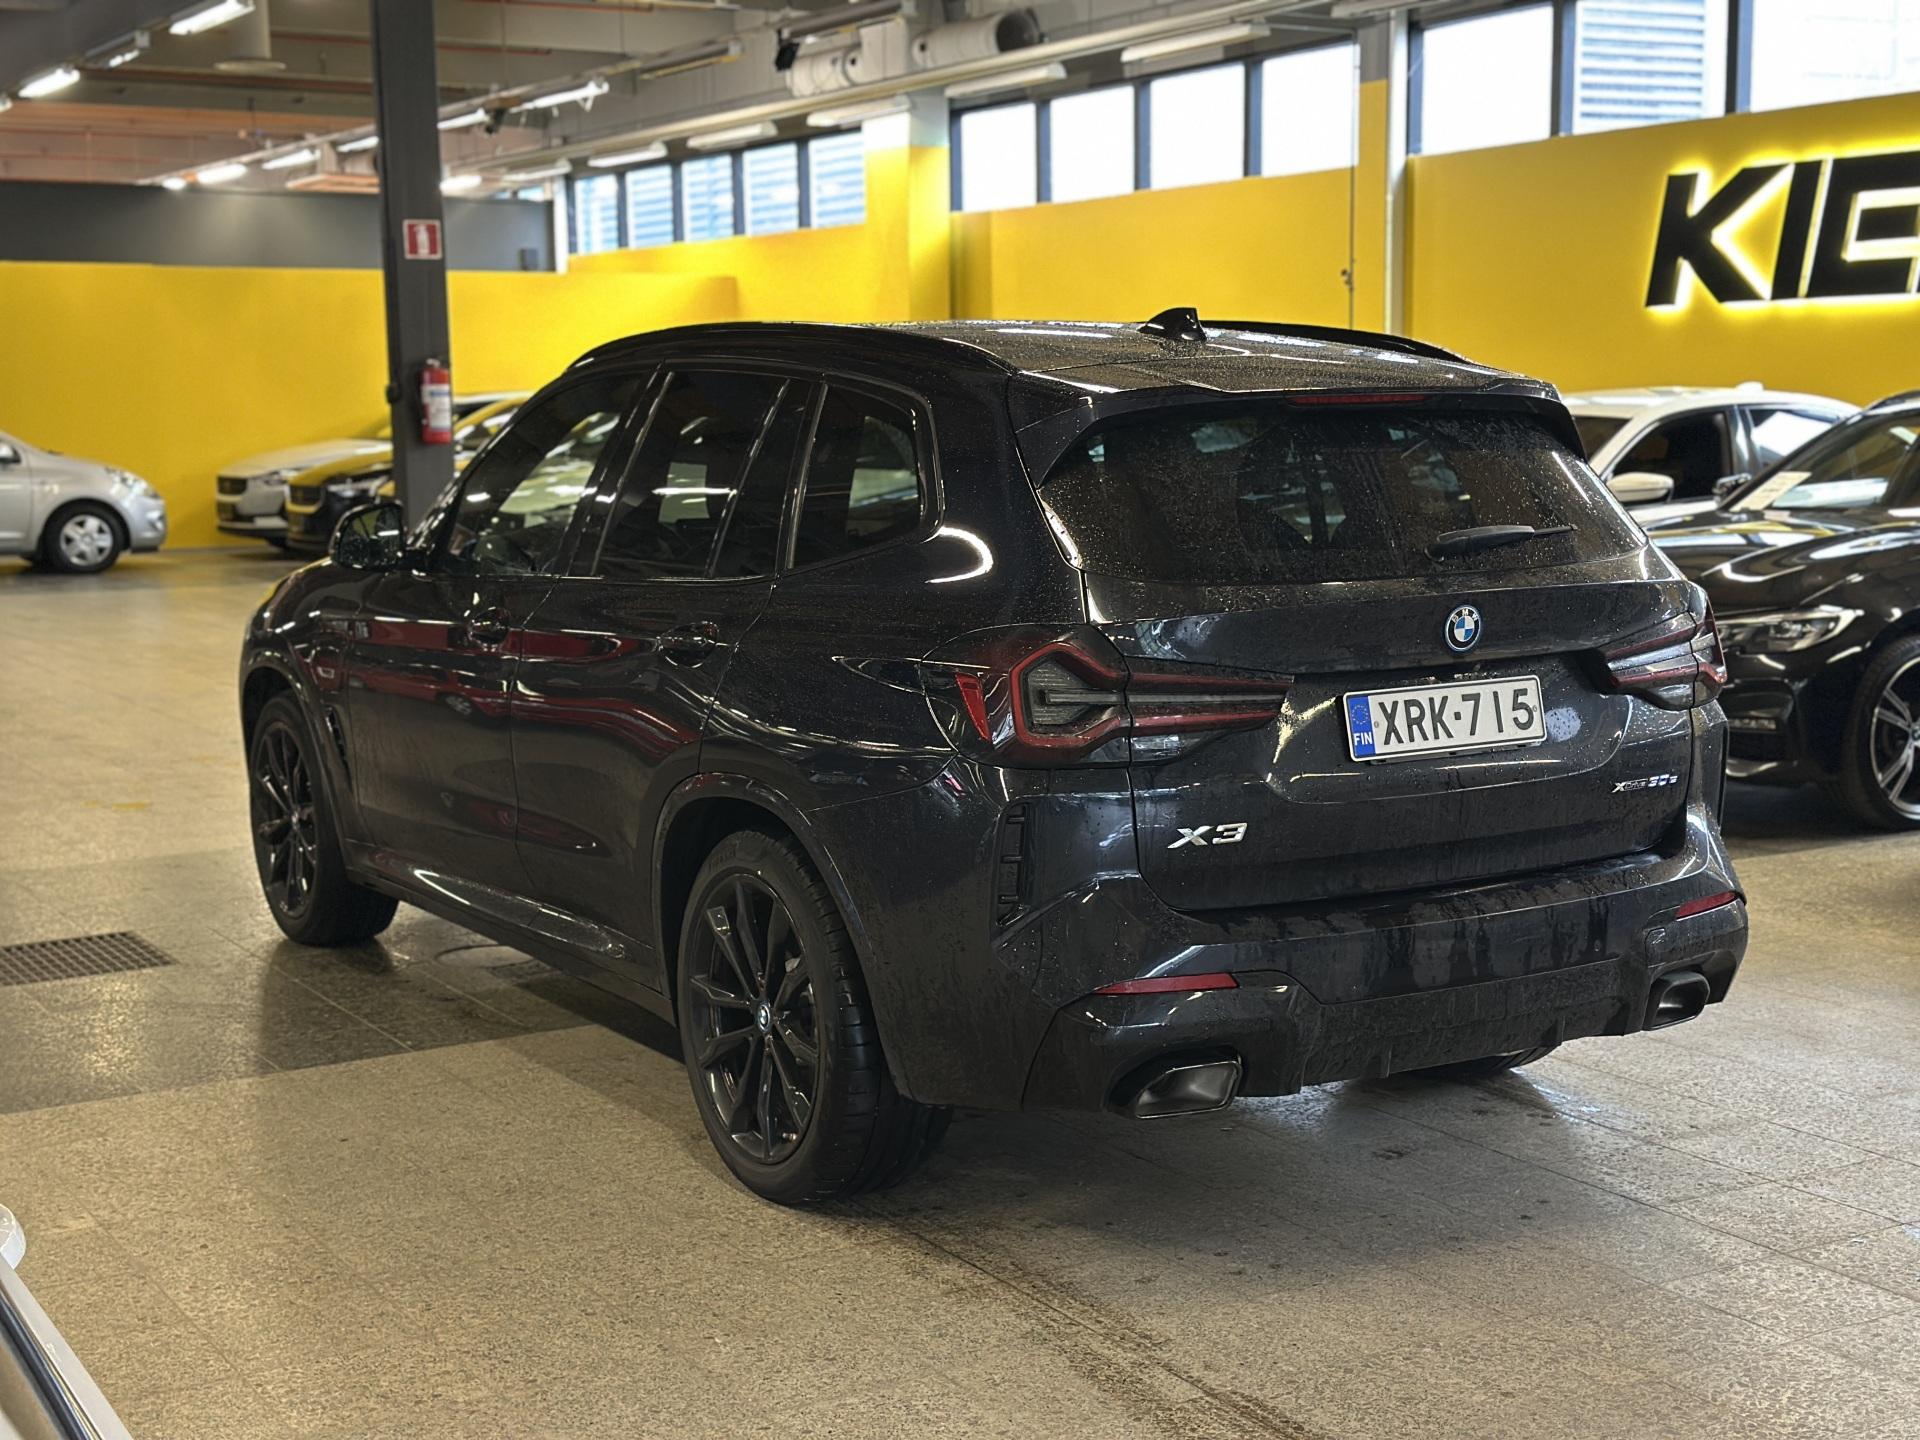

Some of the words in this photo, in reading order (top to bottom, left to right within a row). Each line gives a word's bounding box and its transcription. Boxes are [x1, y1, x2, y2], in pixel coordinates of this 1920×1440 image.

[1645, 150, 1920, 307] KIE
[1451, 608, 1479, 622] BMW
[1378, 688, 1535, 746] XRK-715
[1353, 731, 1373, 746] FIN
[1167, 822, 1248, 848] X3
